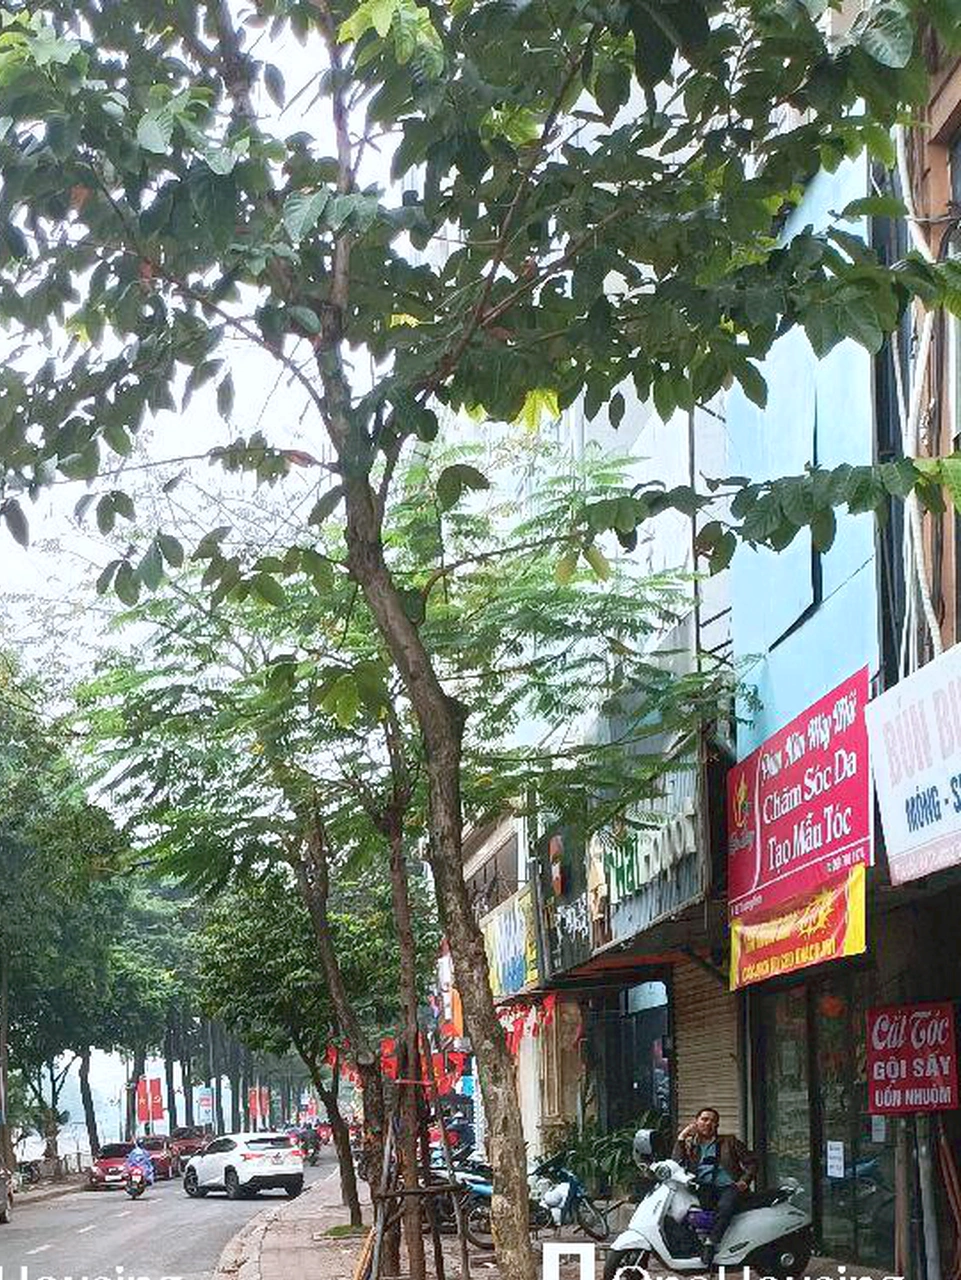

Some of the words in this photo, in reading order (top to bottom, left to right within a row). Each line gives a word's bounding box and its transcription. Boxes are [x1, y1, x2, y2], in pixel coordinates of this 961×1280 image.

[763, 784, 802, 824] Chăm
[804, 764, 832, 801] Sóc
[834, 748, 857, 785] Da
[906, 785, 942, 833] MÓNG
[769, 836, 791, 875] Tạo
[792, 812, 823, 861] Mẫu
[824, 802, 852, 844] Tóc
[872, 1010, 907, 1050] Cắt
[909, 1009, 949, 1050] Tóc
[912, 1050, 951, 1077] SẤY
[875, 1084, 902, 1107] UỐN
[905, 1083, 951, 1109] NHUỘM
